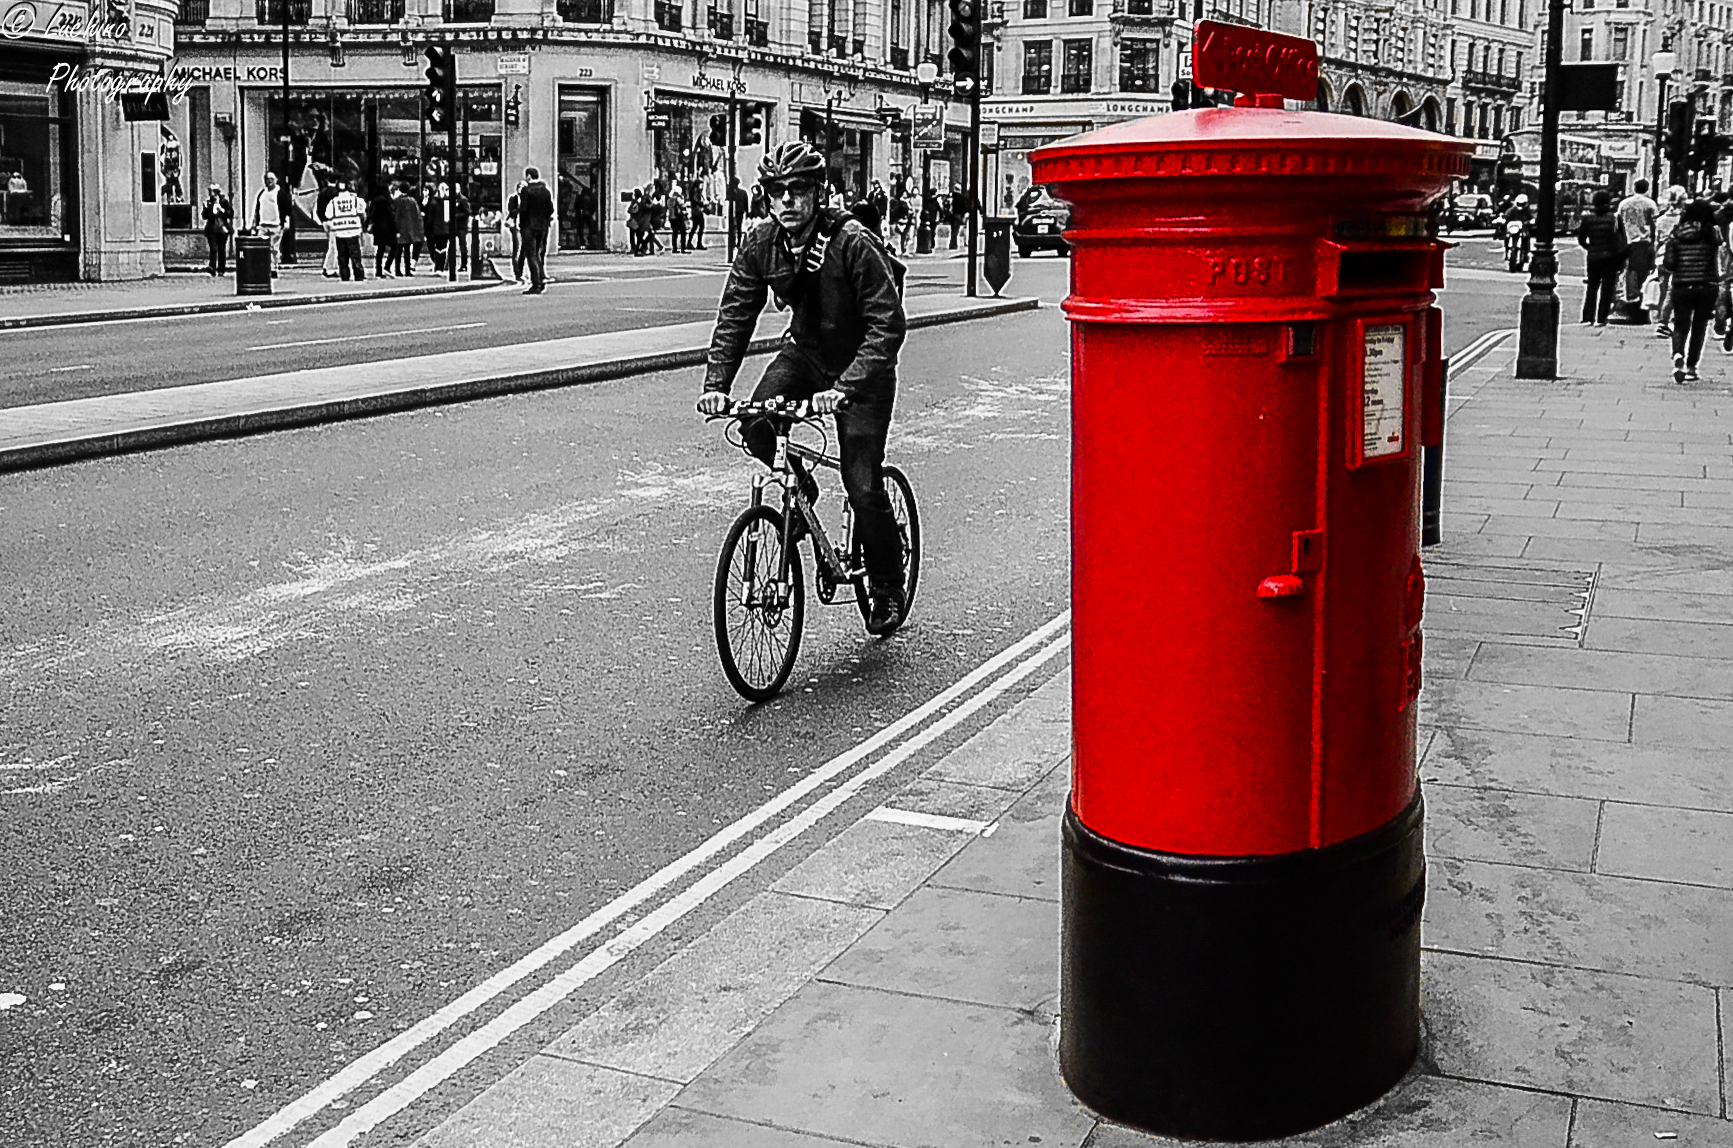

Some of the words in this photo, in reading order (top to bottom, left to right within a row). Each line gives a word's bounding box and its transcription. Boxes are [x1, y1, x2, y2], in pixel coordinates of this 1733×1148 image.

[173, 66, 241, 80] MICHAEL
[692, 75, 725, 91] MICHAEL
[980, 106, 1035, 114] ONGCHAMP
[1106, 104, 1171, 114] LONGCHAMP
[1205, 255, 1290, 286] POST
